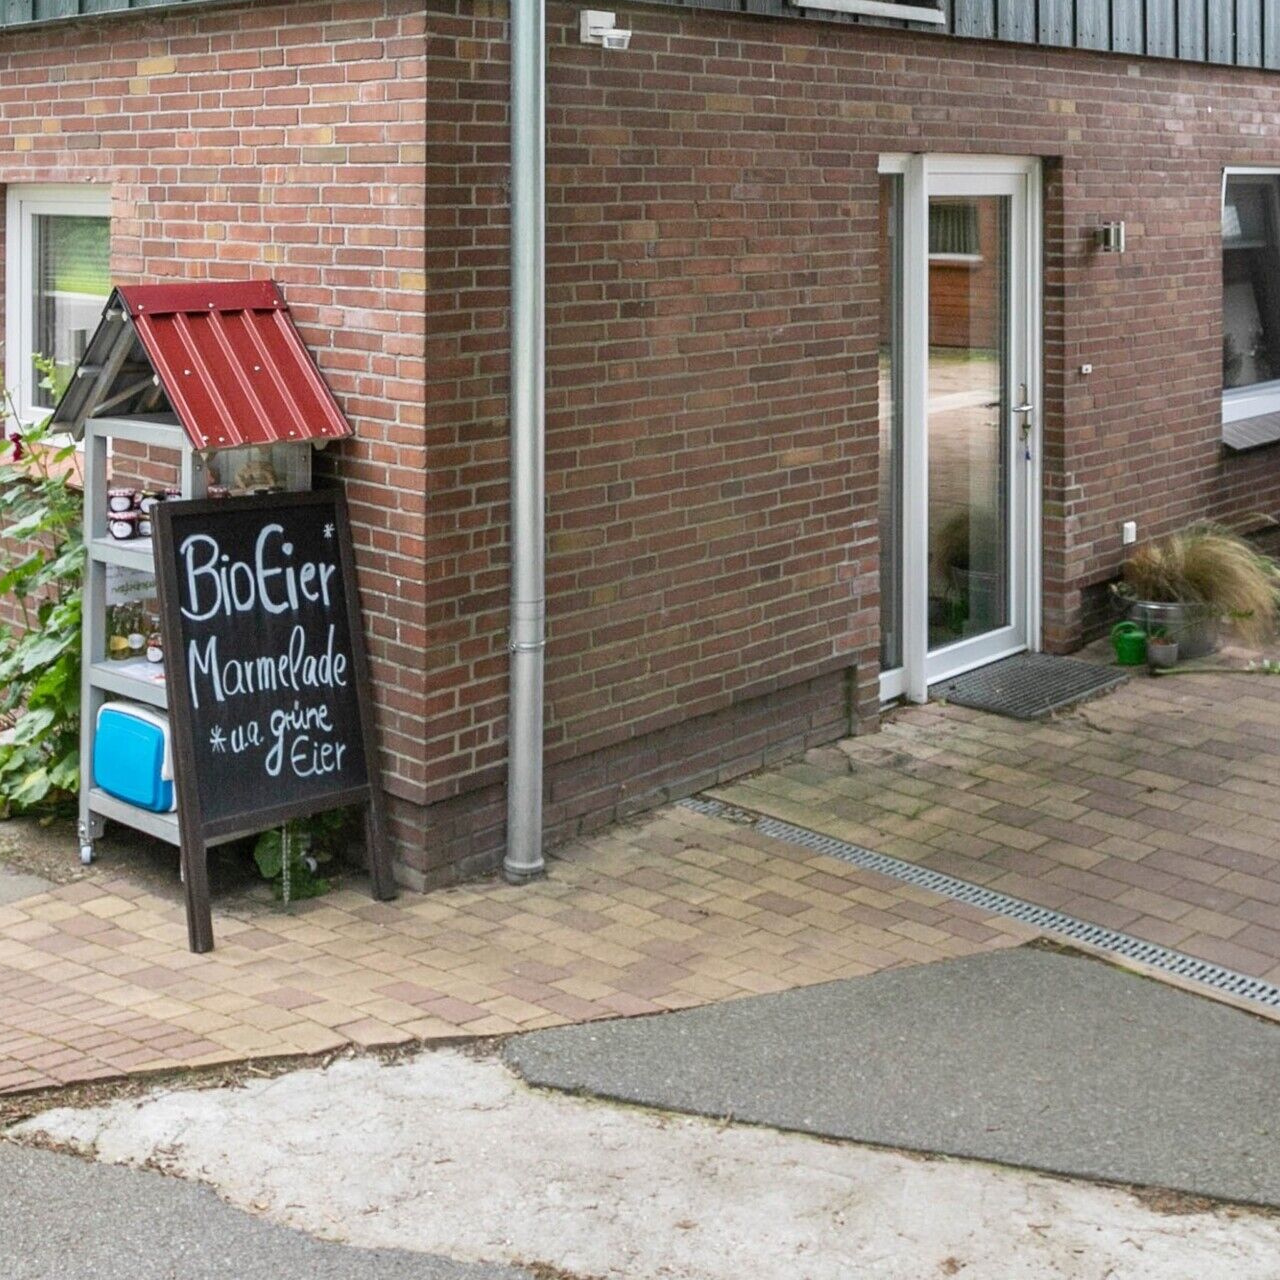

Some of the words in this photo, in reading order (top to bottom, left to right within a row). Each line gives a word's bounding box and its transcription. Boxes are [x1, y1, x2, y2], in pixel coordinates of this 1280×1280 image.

[188, 623, 347, 709] Marmelade
[265, 699, 333, 777] grüne
[290, 735, 347, 777] Eier
